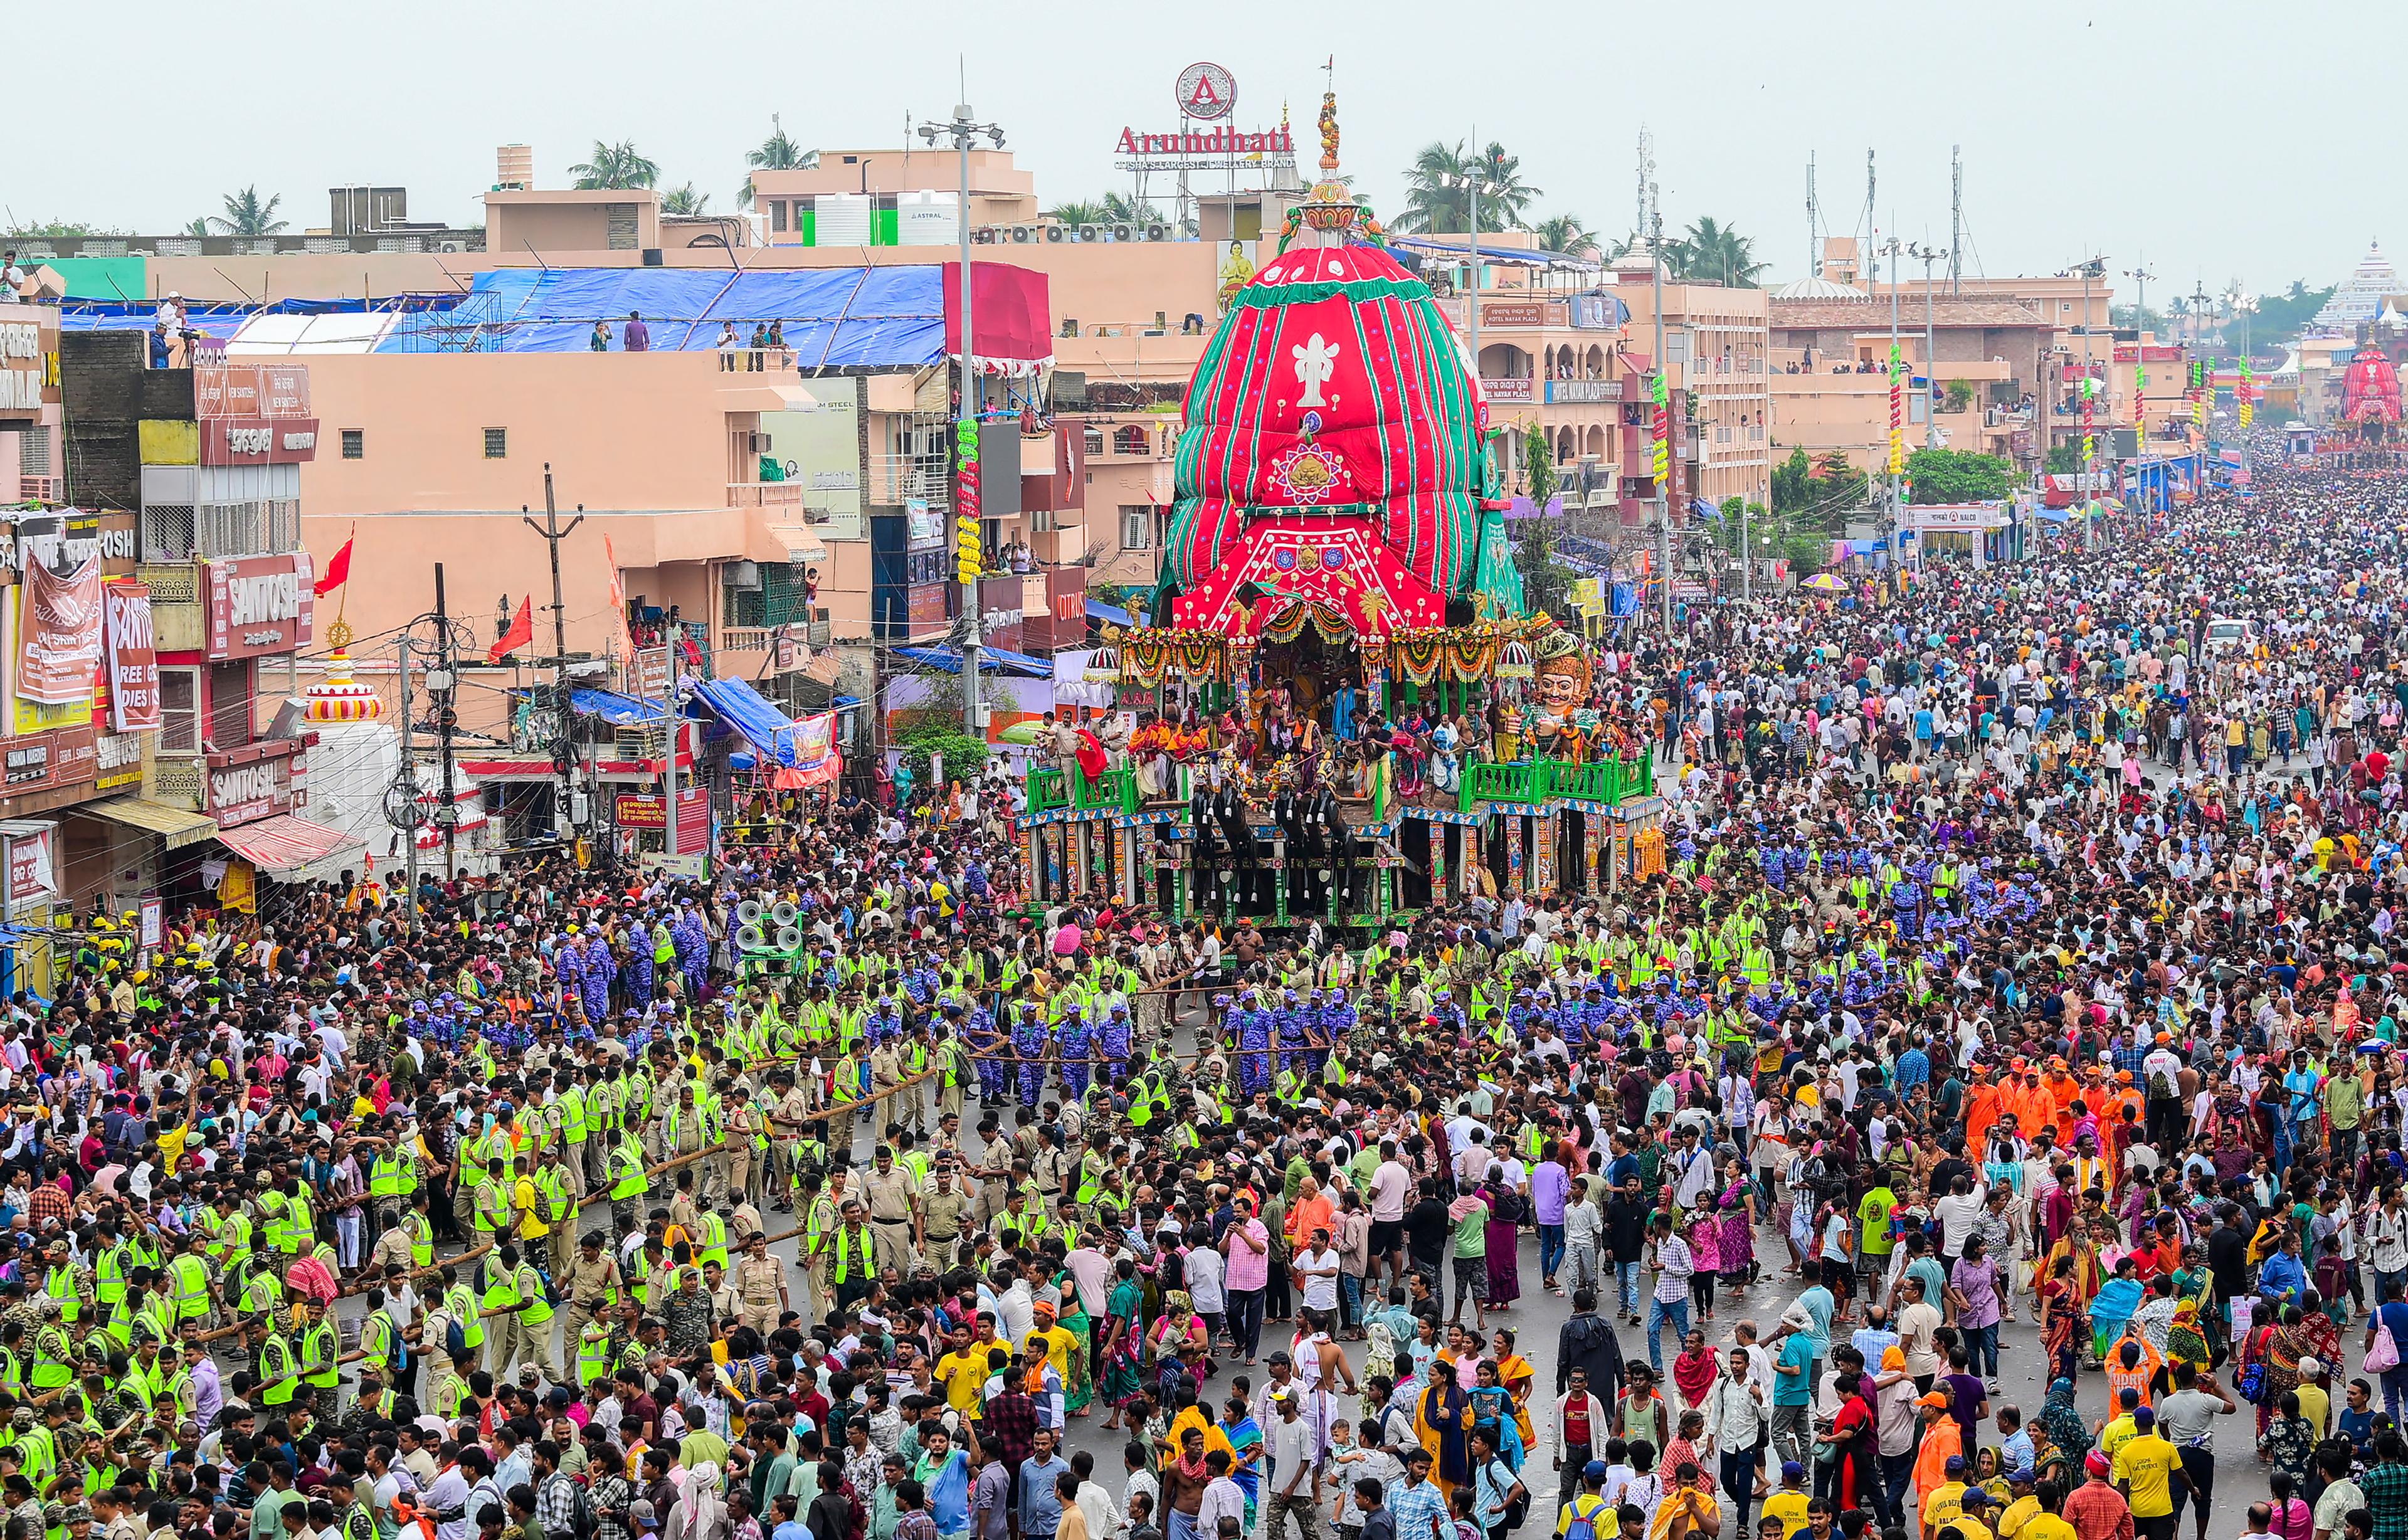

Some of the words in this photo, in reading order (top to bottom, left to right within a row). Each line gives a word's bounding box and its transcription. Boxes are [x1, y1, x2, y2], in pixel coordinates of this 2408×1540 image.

[1114, 122, 1294, 153] Arundhati
[1159, 161, 1200, 169] LARGEST
[1201, 160, 1256, 169] JEWELLERY
[1261, 159, 1292, 169] BRAND
[1553, 382, 1568, 399] HOTEL
[1569, 382, 1585, 400] NAYAK
[1586, 382, 1599, 399] PLAZA
[229, 572, 299, 626] SANTOSH
[1057, 591, 1084, 621] CITRUS
[122, 690, 147, 707] DIES
[97, 731, 140, 769] SANTOSH
[213, 763, 273, 808] SANTOSH
[2113, 1373, 2143, 1386] NDRF
[1935, 1501, 1947, 1512] CIVIL
[1948, 1499, 1961, 1507] DEFE
